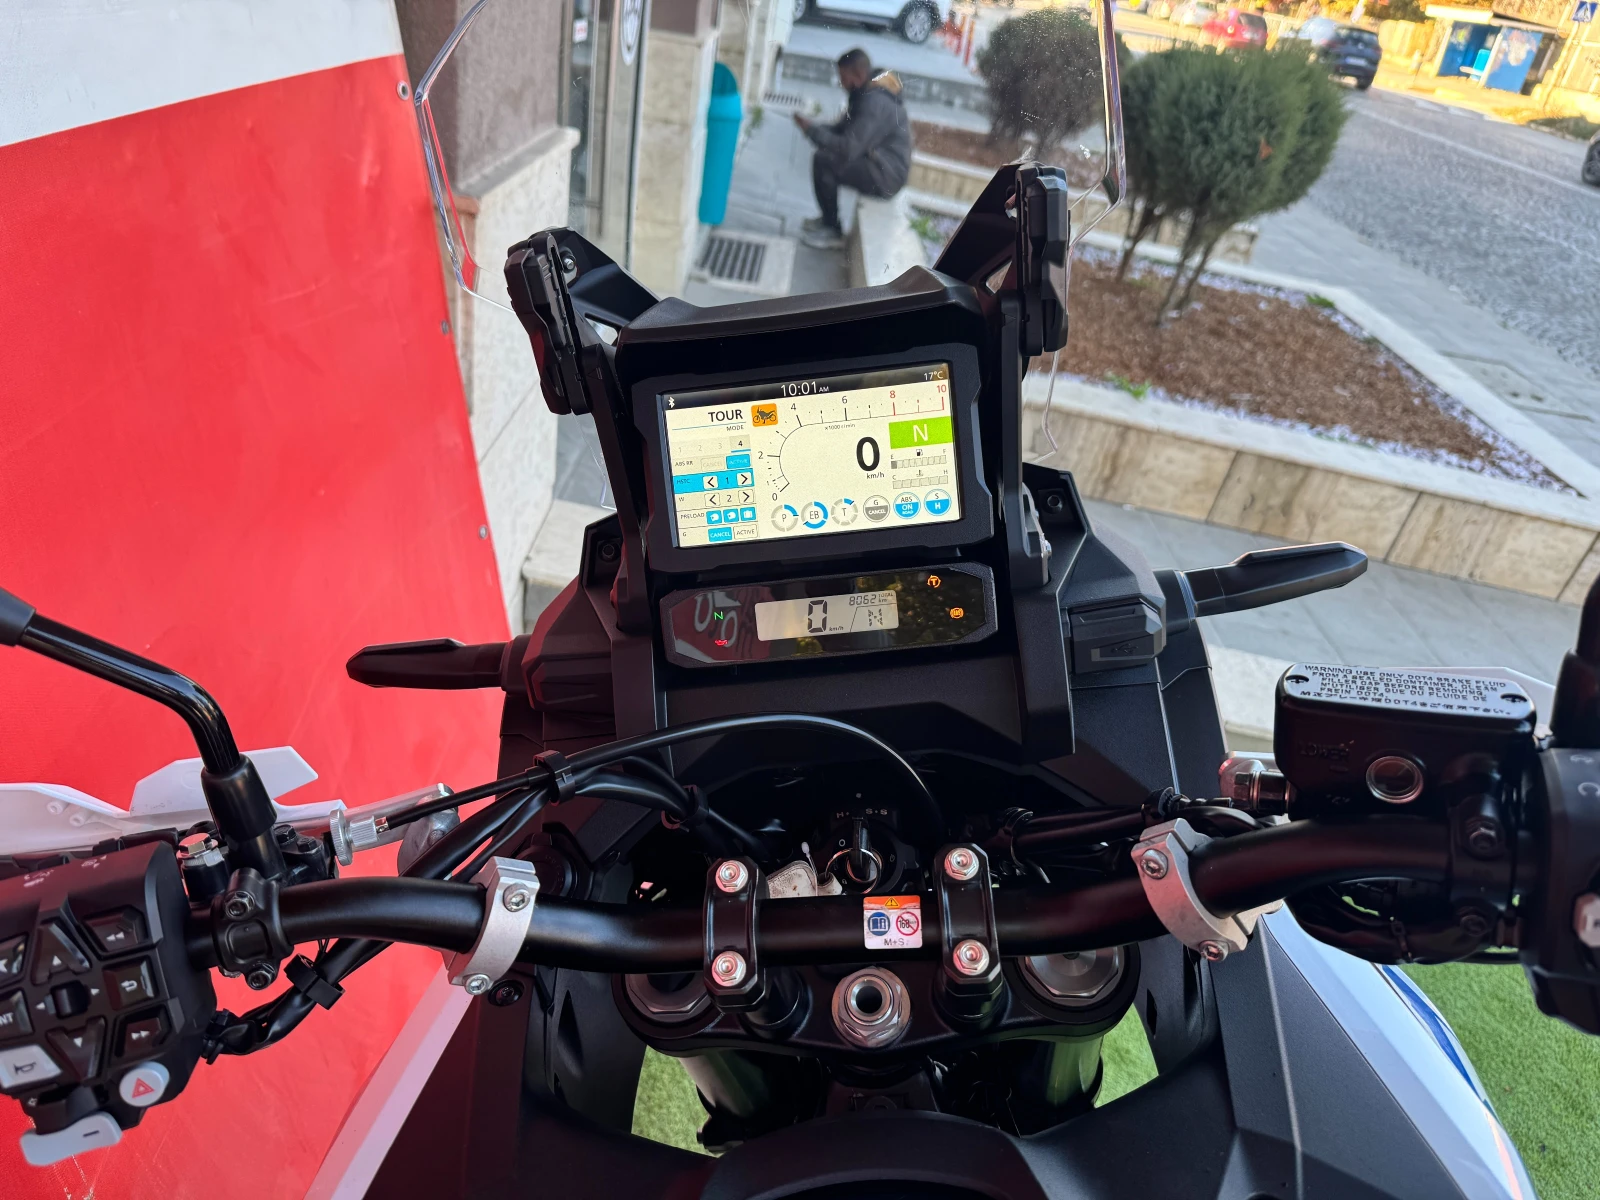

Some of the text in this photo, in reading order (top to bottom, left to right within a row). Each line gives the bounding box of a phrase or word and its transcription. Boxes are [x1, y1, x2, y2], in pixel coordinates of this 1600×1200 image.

[781, 381, 817, 396] 10:01
[936, 384, 947, 393] 10
[889, 390, 896, 398] 8
[841, 396, 848, 404] 6
[790, 403, 796, 411] 4
[708, 409, 743, 422] TOUR
[913, 424, 928, 442] N
[758, 451, 763, 459] 2
[856, 437, 880, 471] 0
[727, 494, 732, 502] 2
[772, 493, 778, 501] 0
[901, 503, 913, 511] ON
[934, 502, 941, 510] H
[809, 511, 819, 520] EB
[842, 507, 847, 516] T
[781, 513, 787, 522] P
[848, 594, 876, 606] 8062
[714, 610, 724, 620] N
[807, 600, 828, 633] 0
[1305, 665, 1352, 674] WARNING
[1429, 691, 1467, 700] FLUIDE
